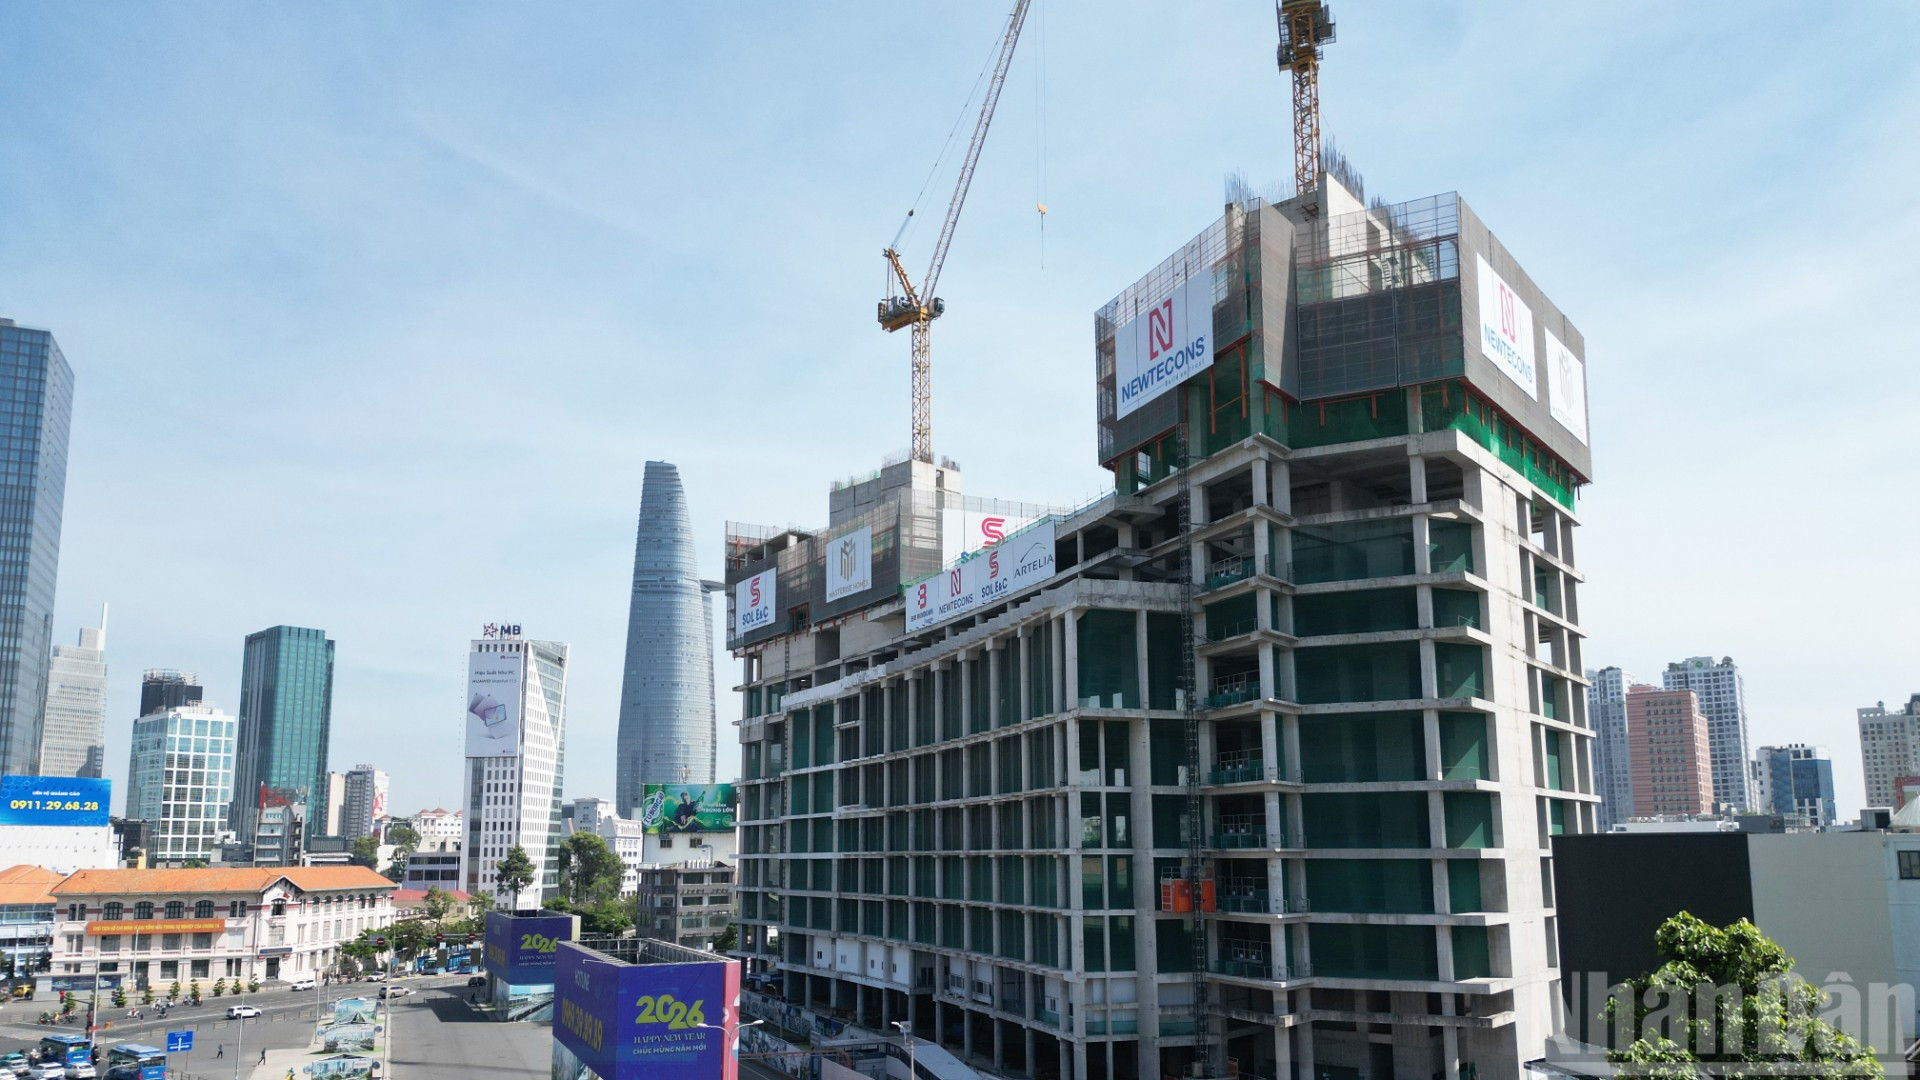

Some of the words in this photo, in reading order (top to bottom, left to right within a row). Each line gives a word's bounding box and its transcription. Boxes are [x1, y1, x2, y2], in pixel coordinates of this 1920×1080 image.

[1484, 323, 1533, 384] NEWTECONS
[1121, 336, 1205, 404] NEWTECONS
[1014, 554, 1054, 579] ARTELIA
[981, 583, 994, 599] SOL
[994, 577, 1008, 593] E&C
[939, 593, 974, 615] NEWTECONS
[742, 610, 755, 626] SOL
[755, 605, 769, 621] E&C
[500, 625, 521, 635] MB
[10, 800, 99, 811] 0911.29.68.28
[643, 796, 664, 824] TUBORG
[520, 933, 559, 953] 2026
[635, 994, 705, 1030] 2026
[633, 1034, 662, 1044] HAPPY
[663, 1033, 683, 1042] NEW
[684, 1032, 706, 1041] YEAR
[632, 1046, 652, 1055] CHÚC
